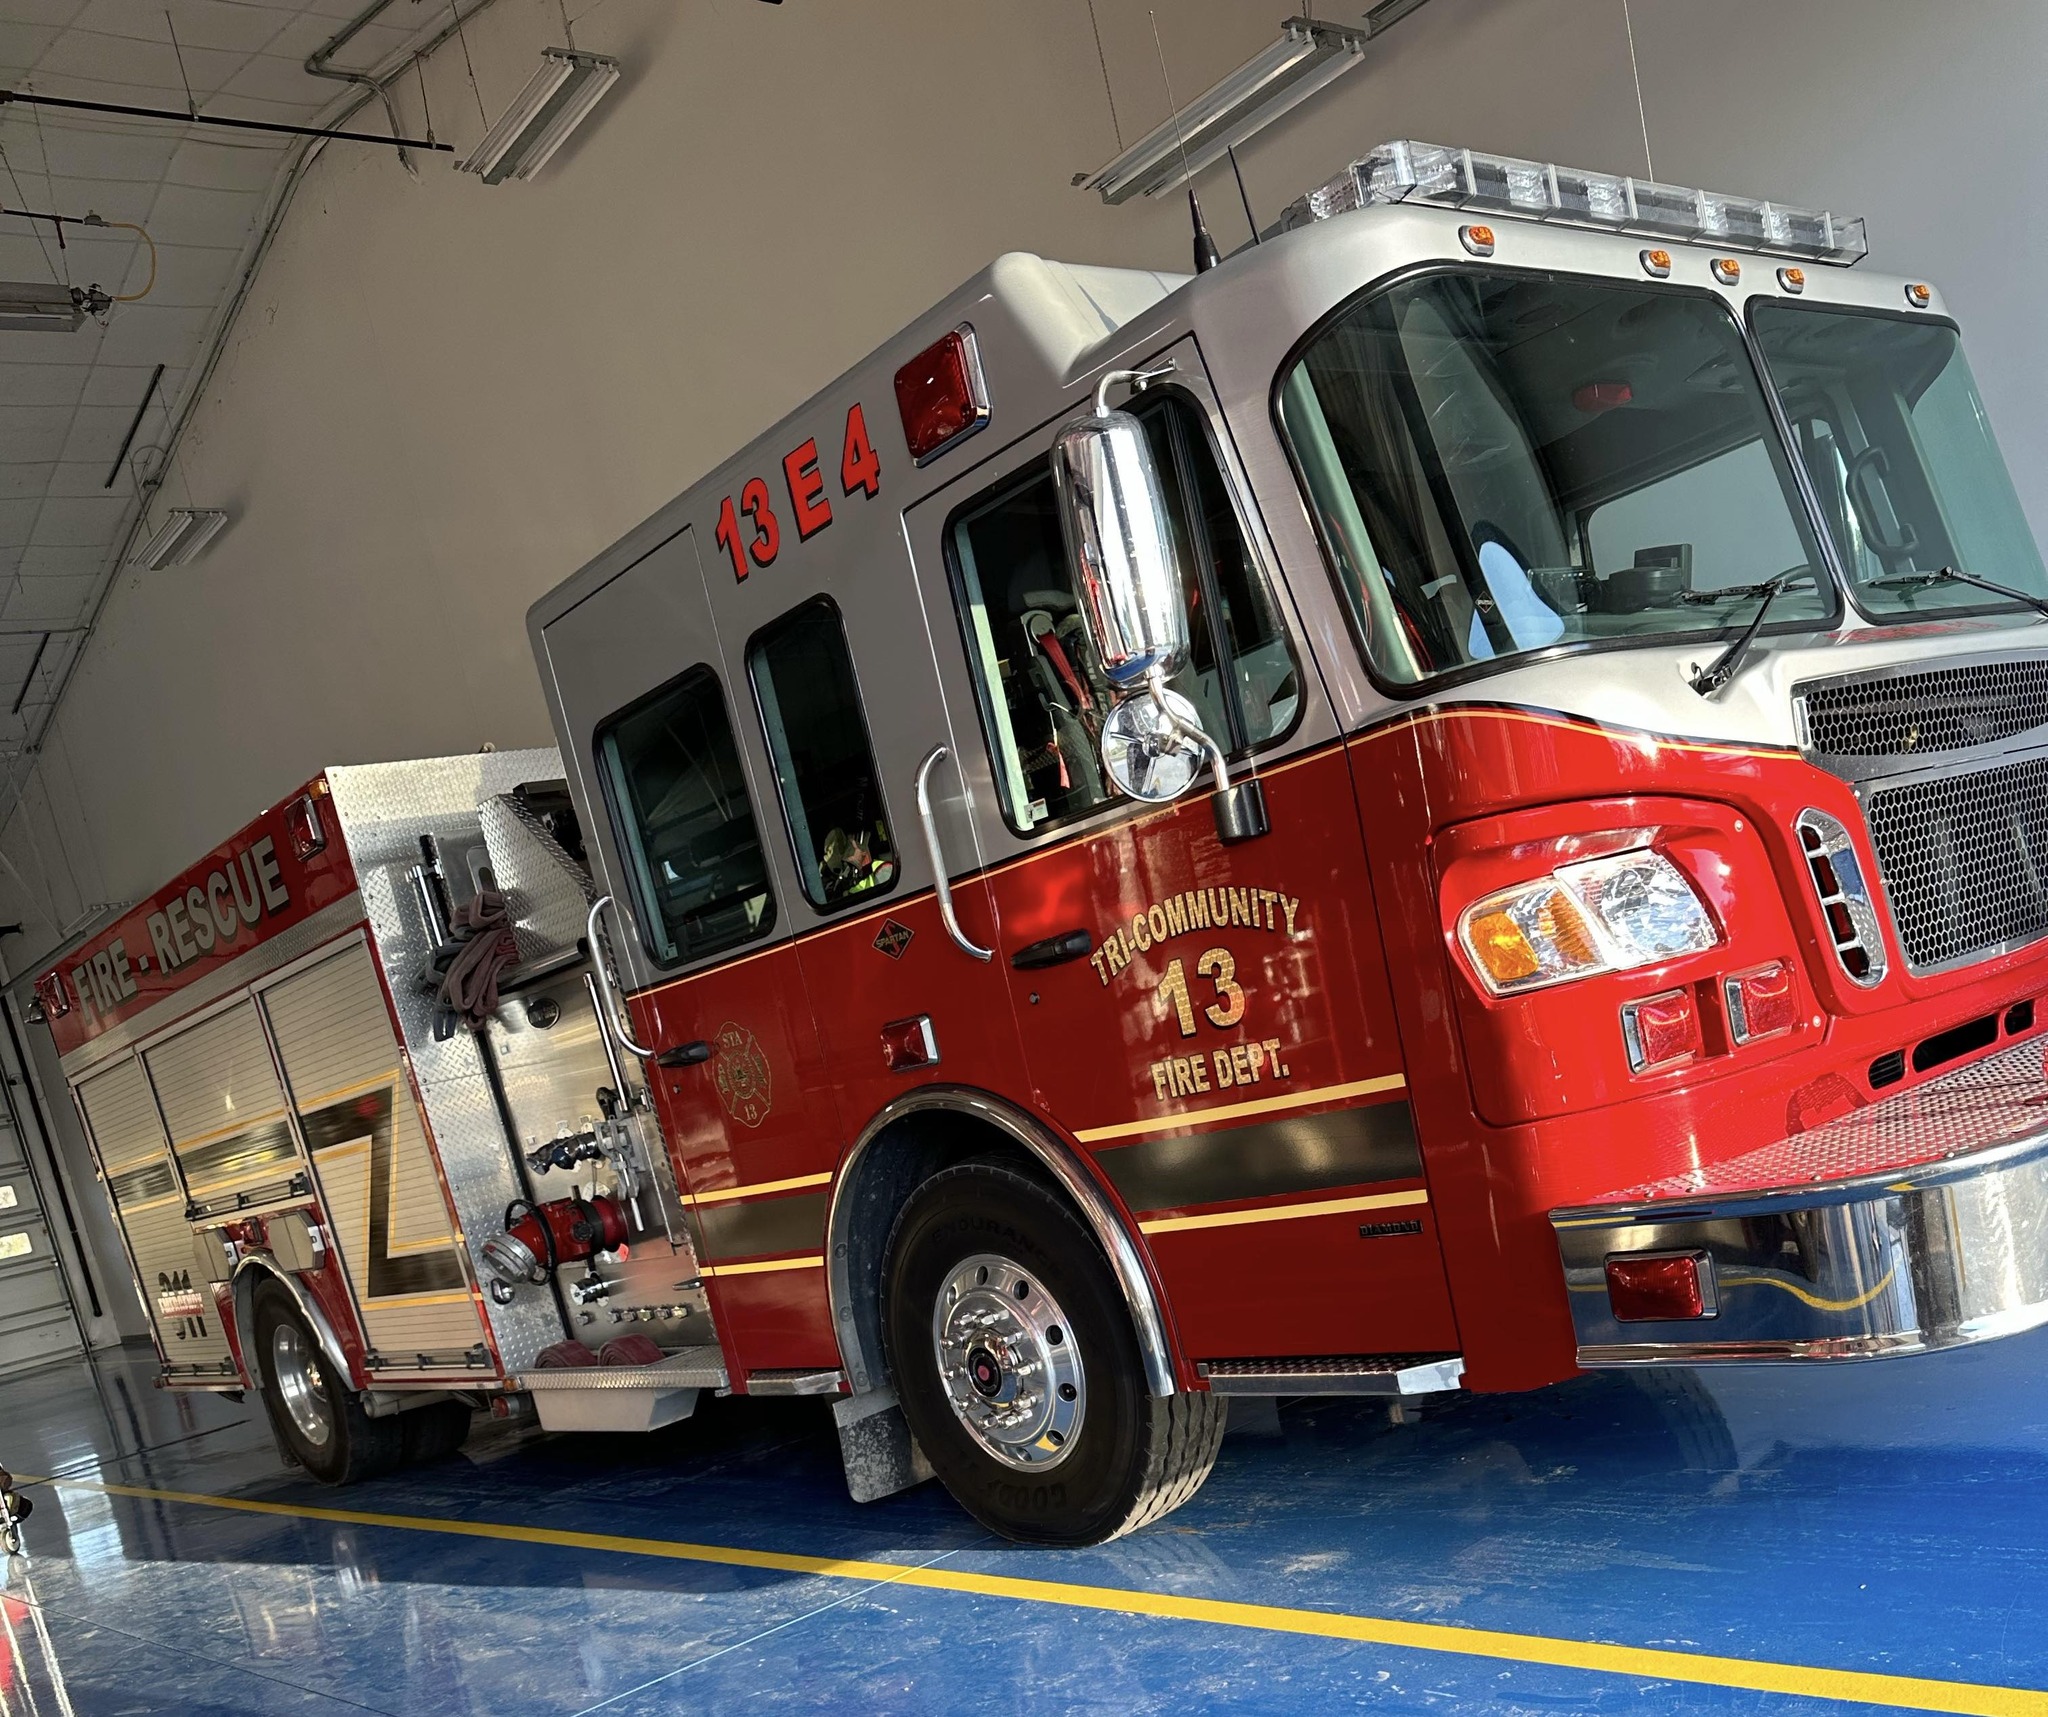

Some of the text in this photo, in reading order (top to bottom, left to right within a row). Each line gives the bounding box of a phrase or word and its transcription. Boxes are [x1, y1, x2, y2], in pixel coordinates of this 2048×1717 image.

[875, 930, 910, 949] SPARTAN
[1089, 886, 1300, 987] TRI-COMMUNITY
[1156, 947, 1247, 1039] 13
[722, 1030, 743, 1048] STA
[1150, 1037, 1291, 1101] FIRE DEPT.
[743, 1103, 758, 1121] 13
[1360, 1219, 1421, 1237] DIAMOND
